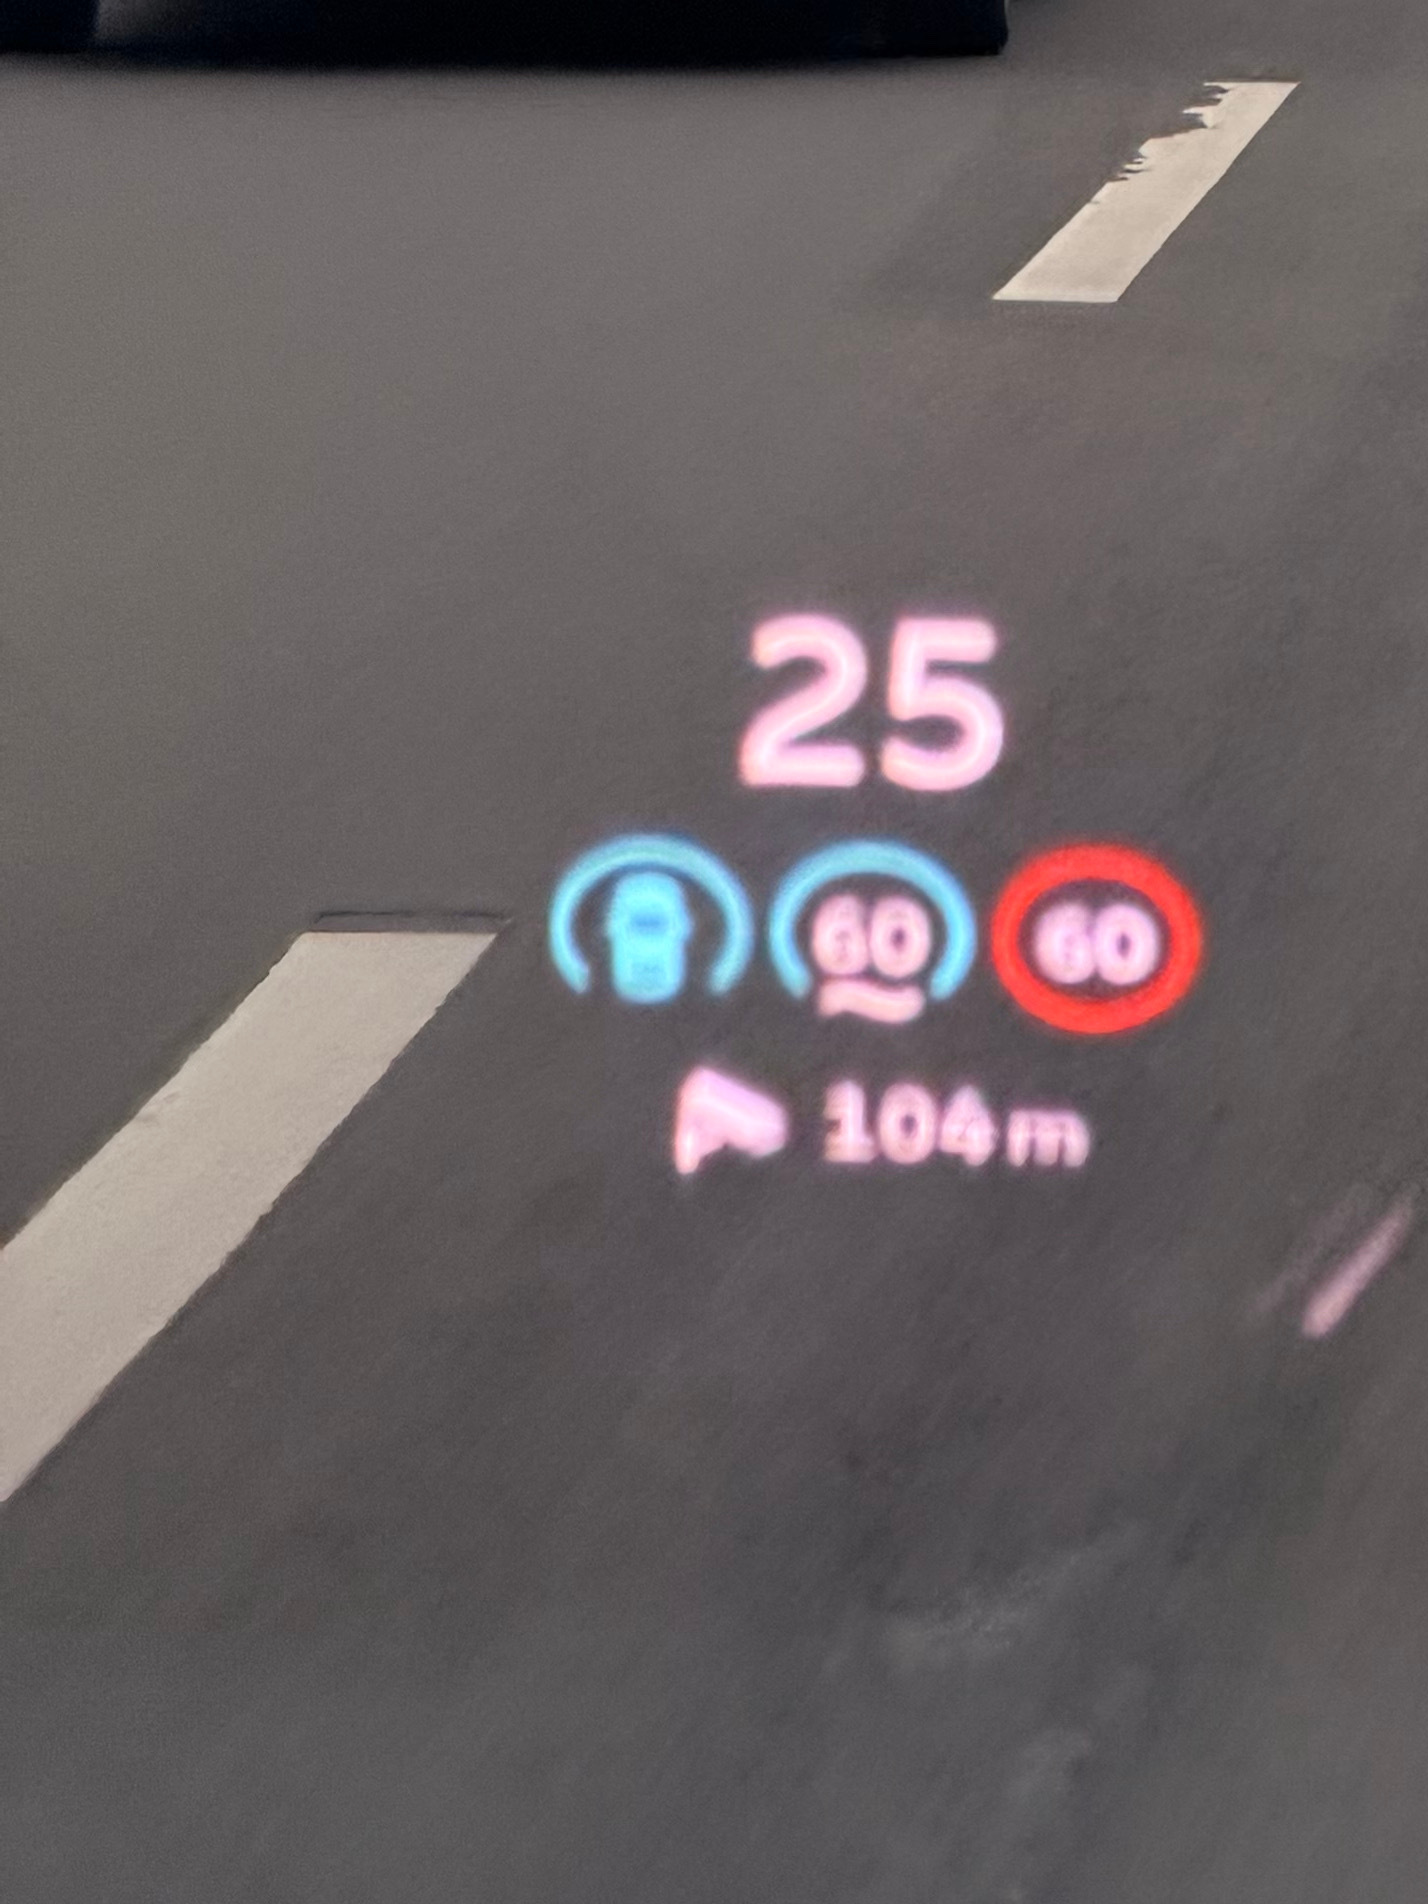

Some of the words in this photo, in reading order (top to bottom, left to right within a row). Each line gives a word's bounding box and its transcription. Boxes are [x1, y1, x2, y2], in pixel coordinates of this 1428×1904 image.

[738, 612, 1006, 793] 25
[811, 894, 933, 980] 60
[1033, 901, 1163, 988] 60
